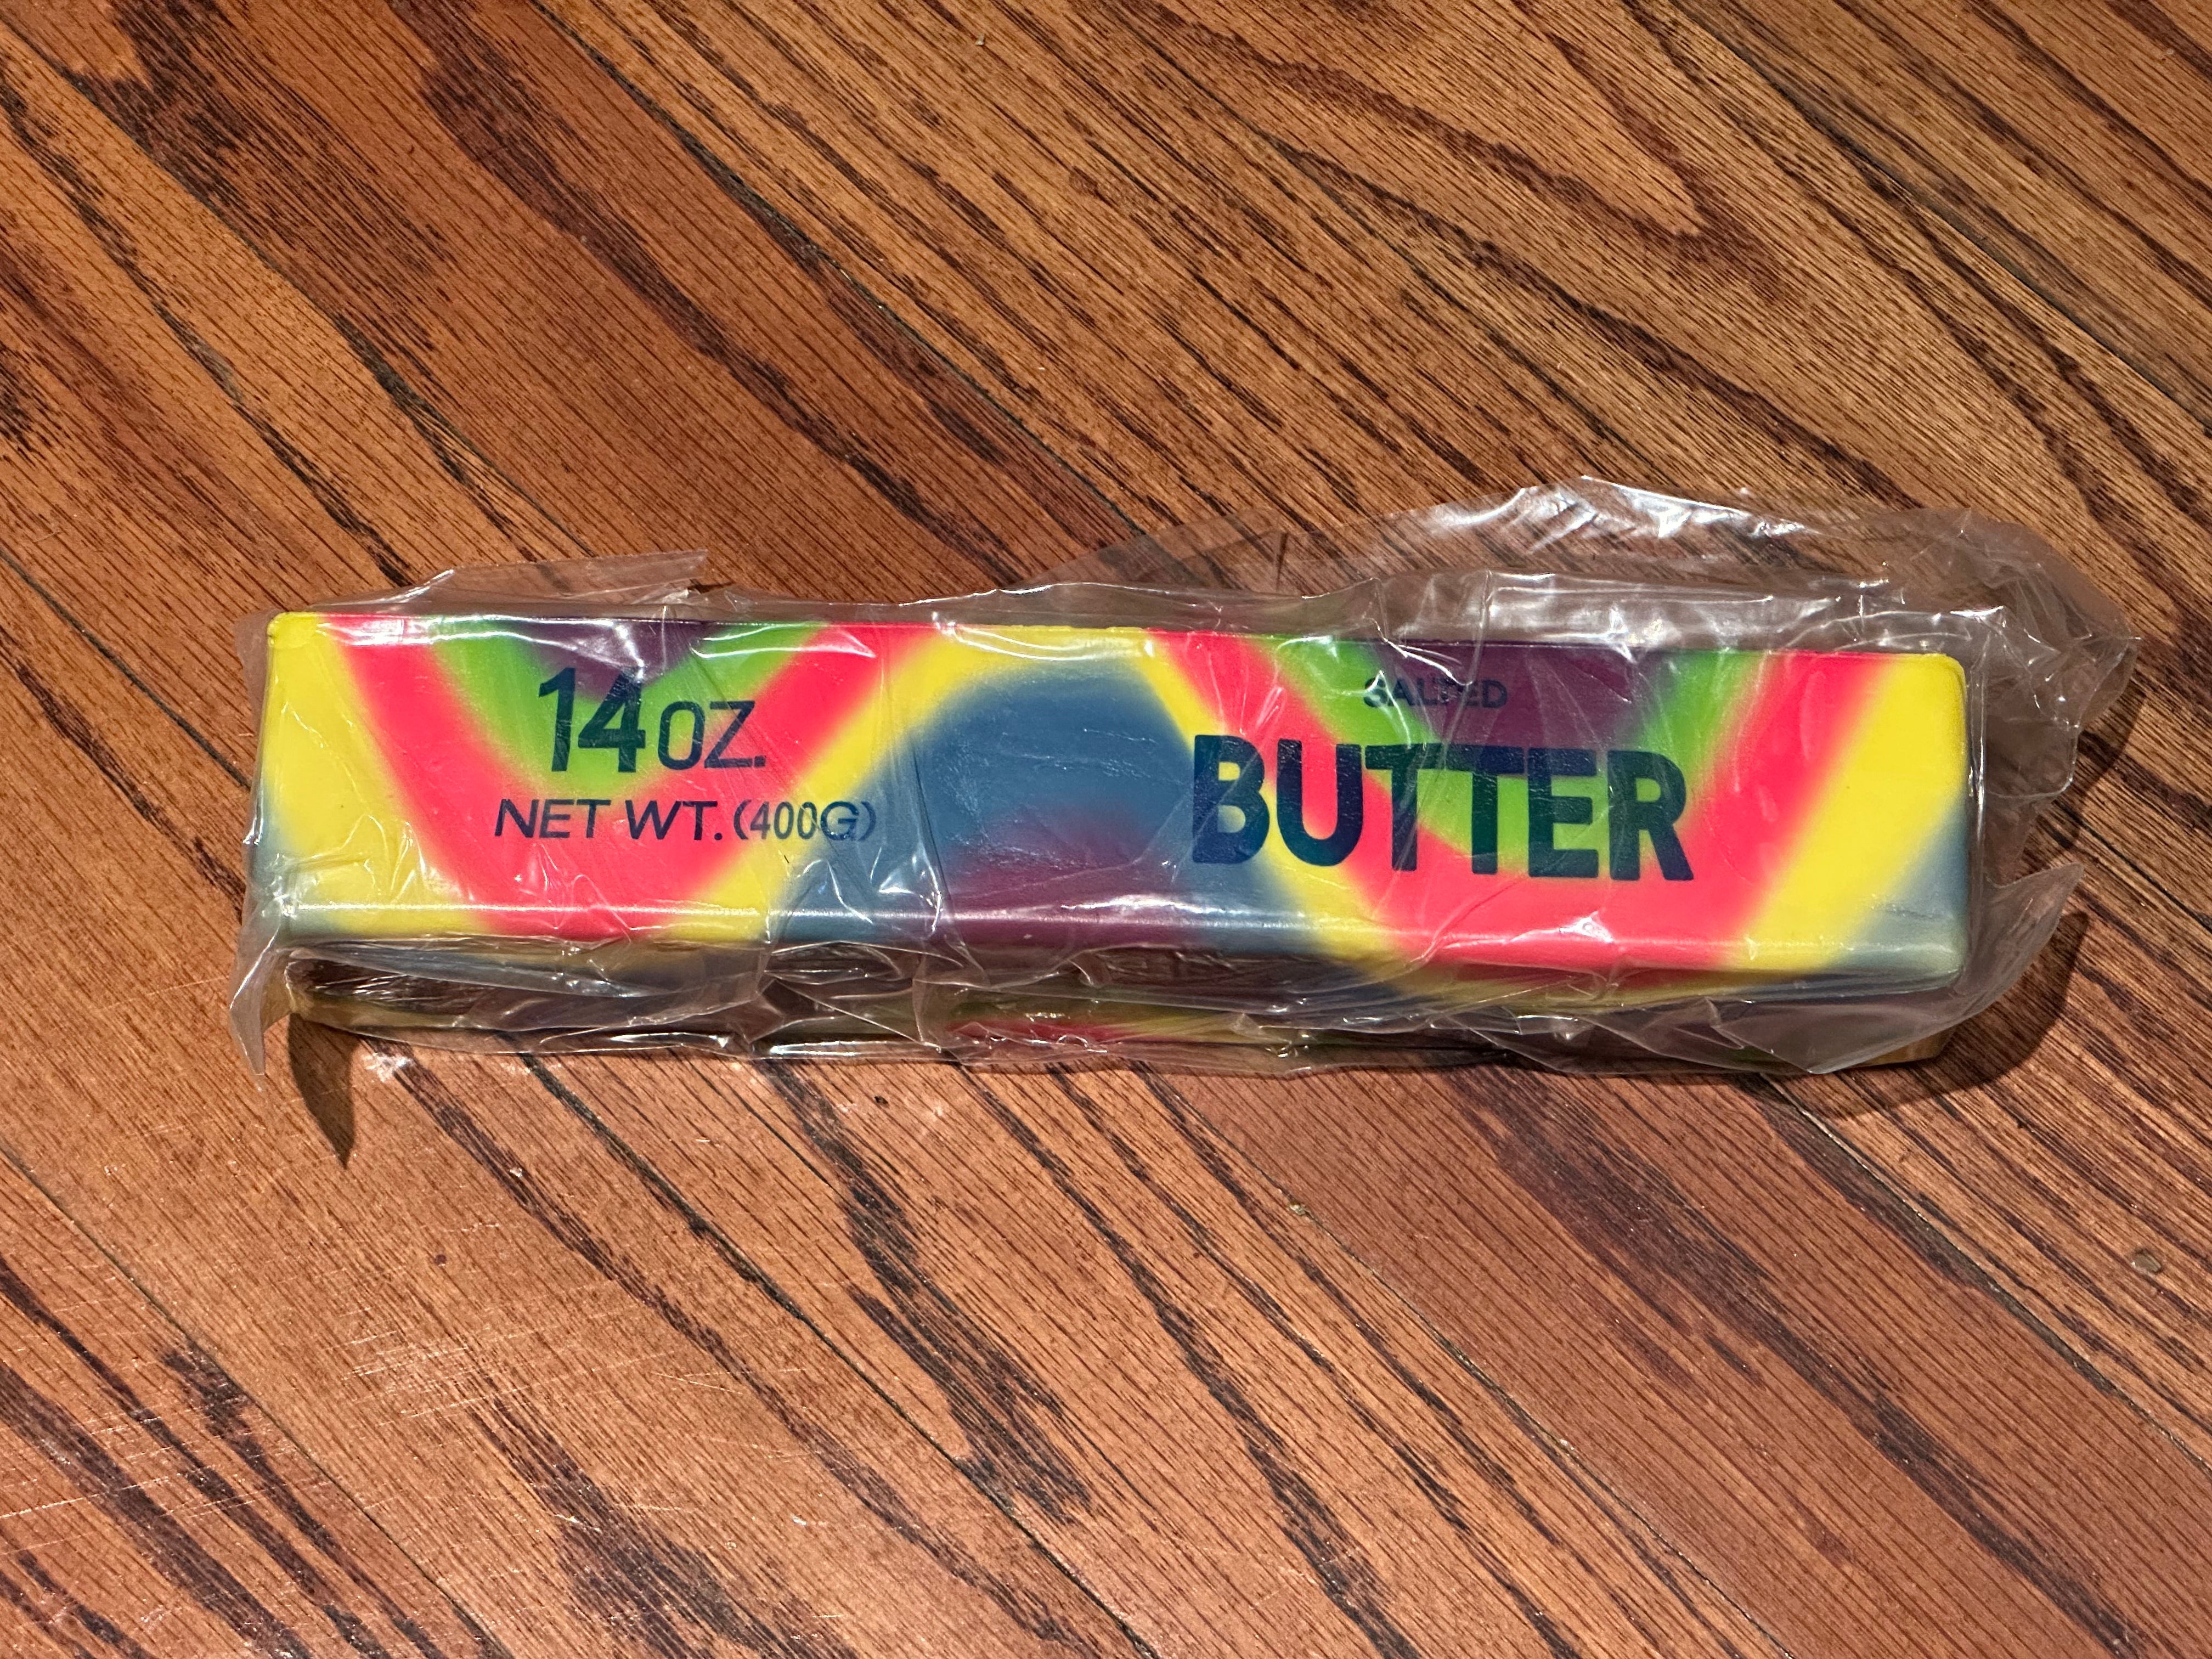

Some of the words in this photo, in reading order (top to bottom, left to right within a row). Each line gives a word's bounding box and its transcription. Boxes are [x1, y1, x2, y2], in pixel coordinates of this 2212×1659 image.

[538, 667, 646, 773] 14
[658, 700, 766, 770] OZ.
[494, 798, 611, 838] NET
[624, 800, 724, 841] WT.
[733, 799, 876, 841] (400G)
[1191, 734, 1694, 882] BUTTER
